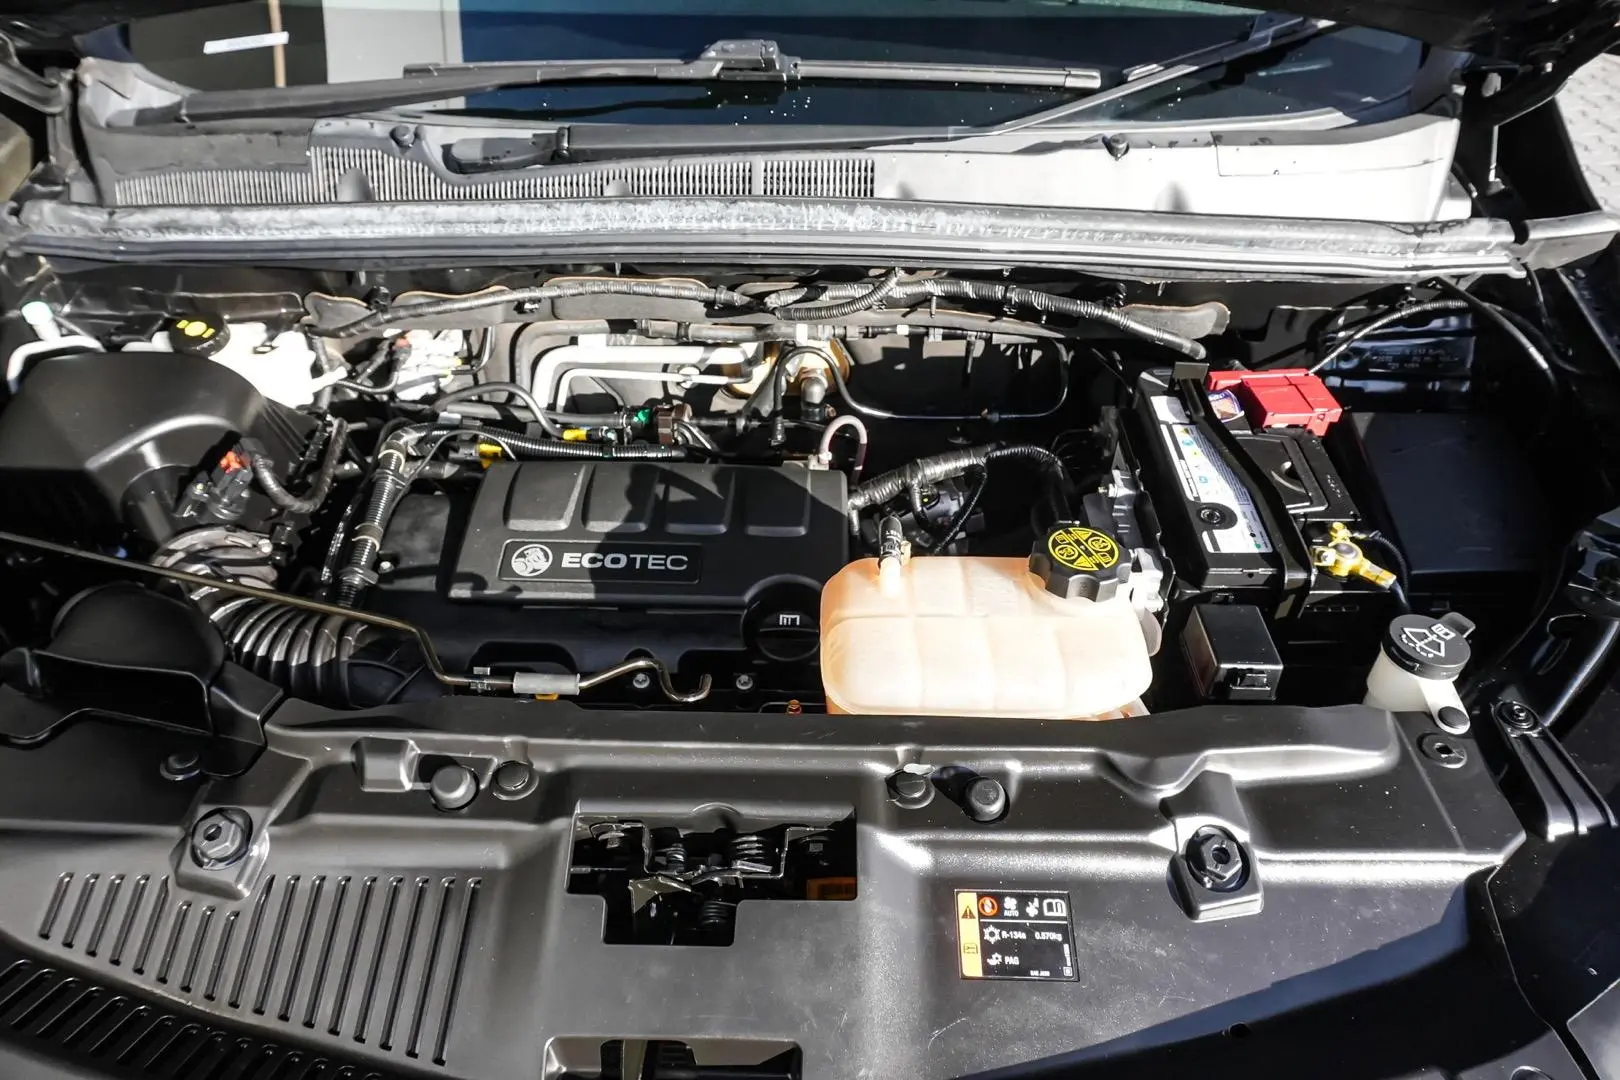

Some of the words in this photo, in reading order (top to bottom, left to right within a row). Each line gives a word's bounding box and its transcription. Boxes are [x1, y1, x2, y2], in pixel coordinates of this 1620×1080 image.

[561, 552, 689, 571] ECOTEC
[1004, 909, 1019, 917] AUTO
[1001, 930, 1027, 940] R-134a
[1004, 955, 1020, 966] PAG
